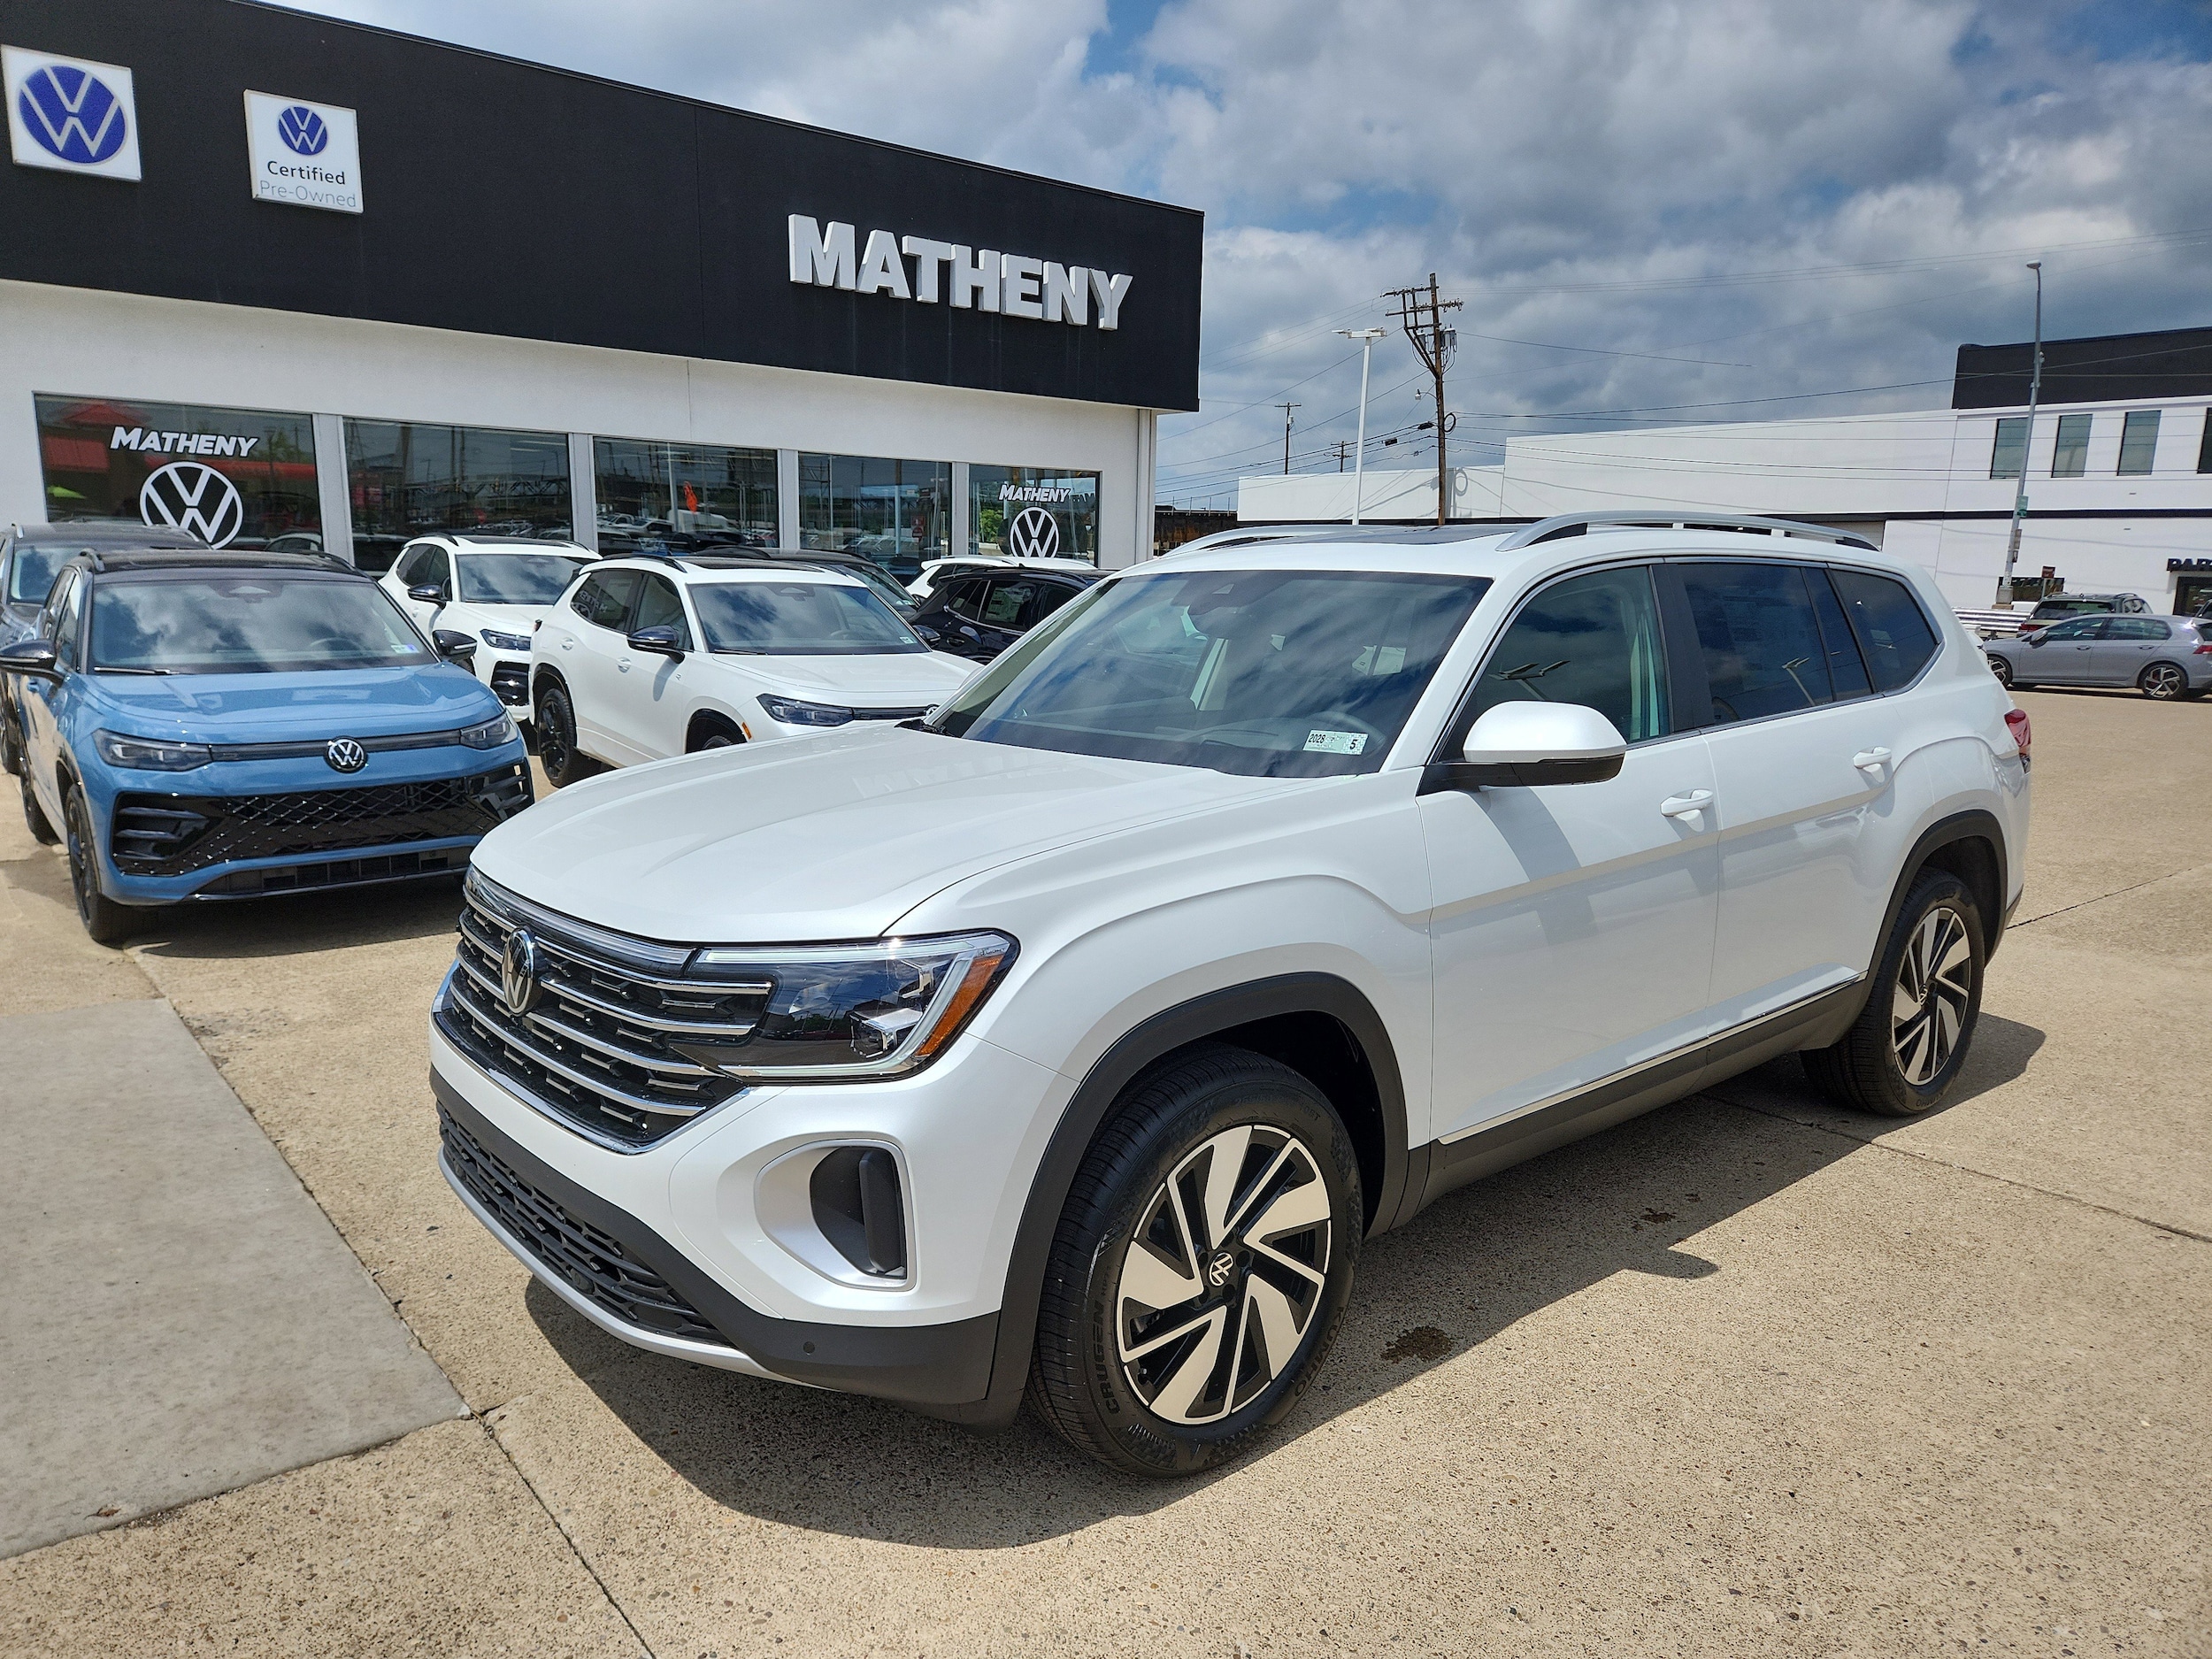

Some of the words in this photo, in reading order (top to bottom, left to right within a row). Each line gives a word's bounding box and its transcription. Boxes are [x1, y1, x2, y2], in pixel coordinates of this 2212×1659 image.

[267, 160, 346, 185] Certified
[260, 180, 357, 207] Pre-Owned
[788, 213, 1133, 331] MATHENY
[110, 426, 258, 457] MATHENY
[998, 484, 1071, 503] MATHENY
[1349, 739, 1358, 750] 5
[1093, 1300, 1120, 1414] CRUGEN
[1295, 1306, 1345, 1396] KUMHO
